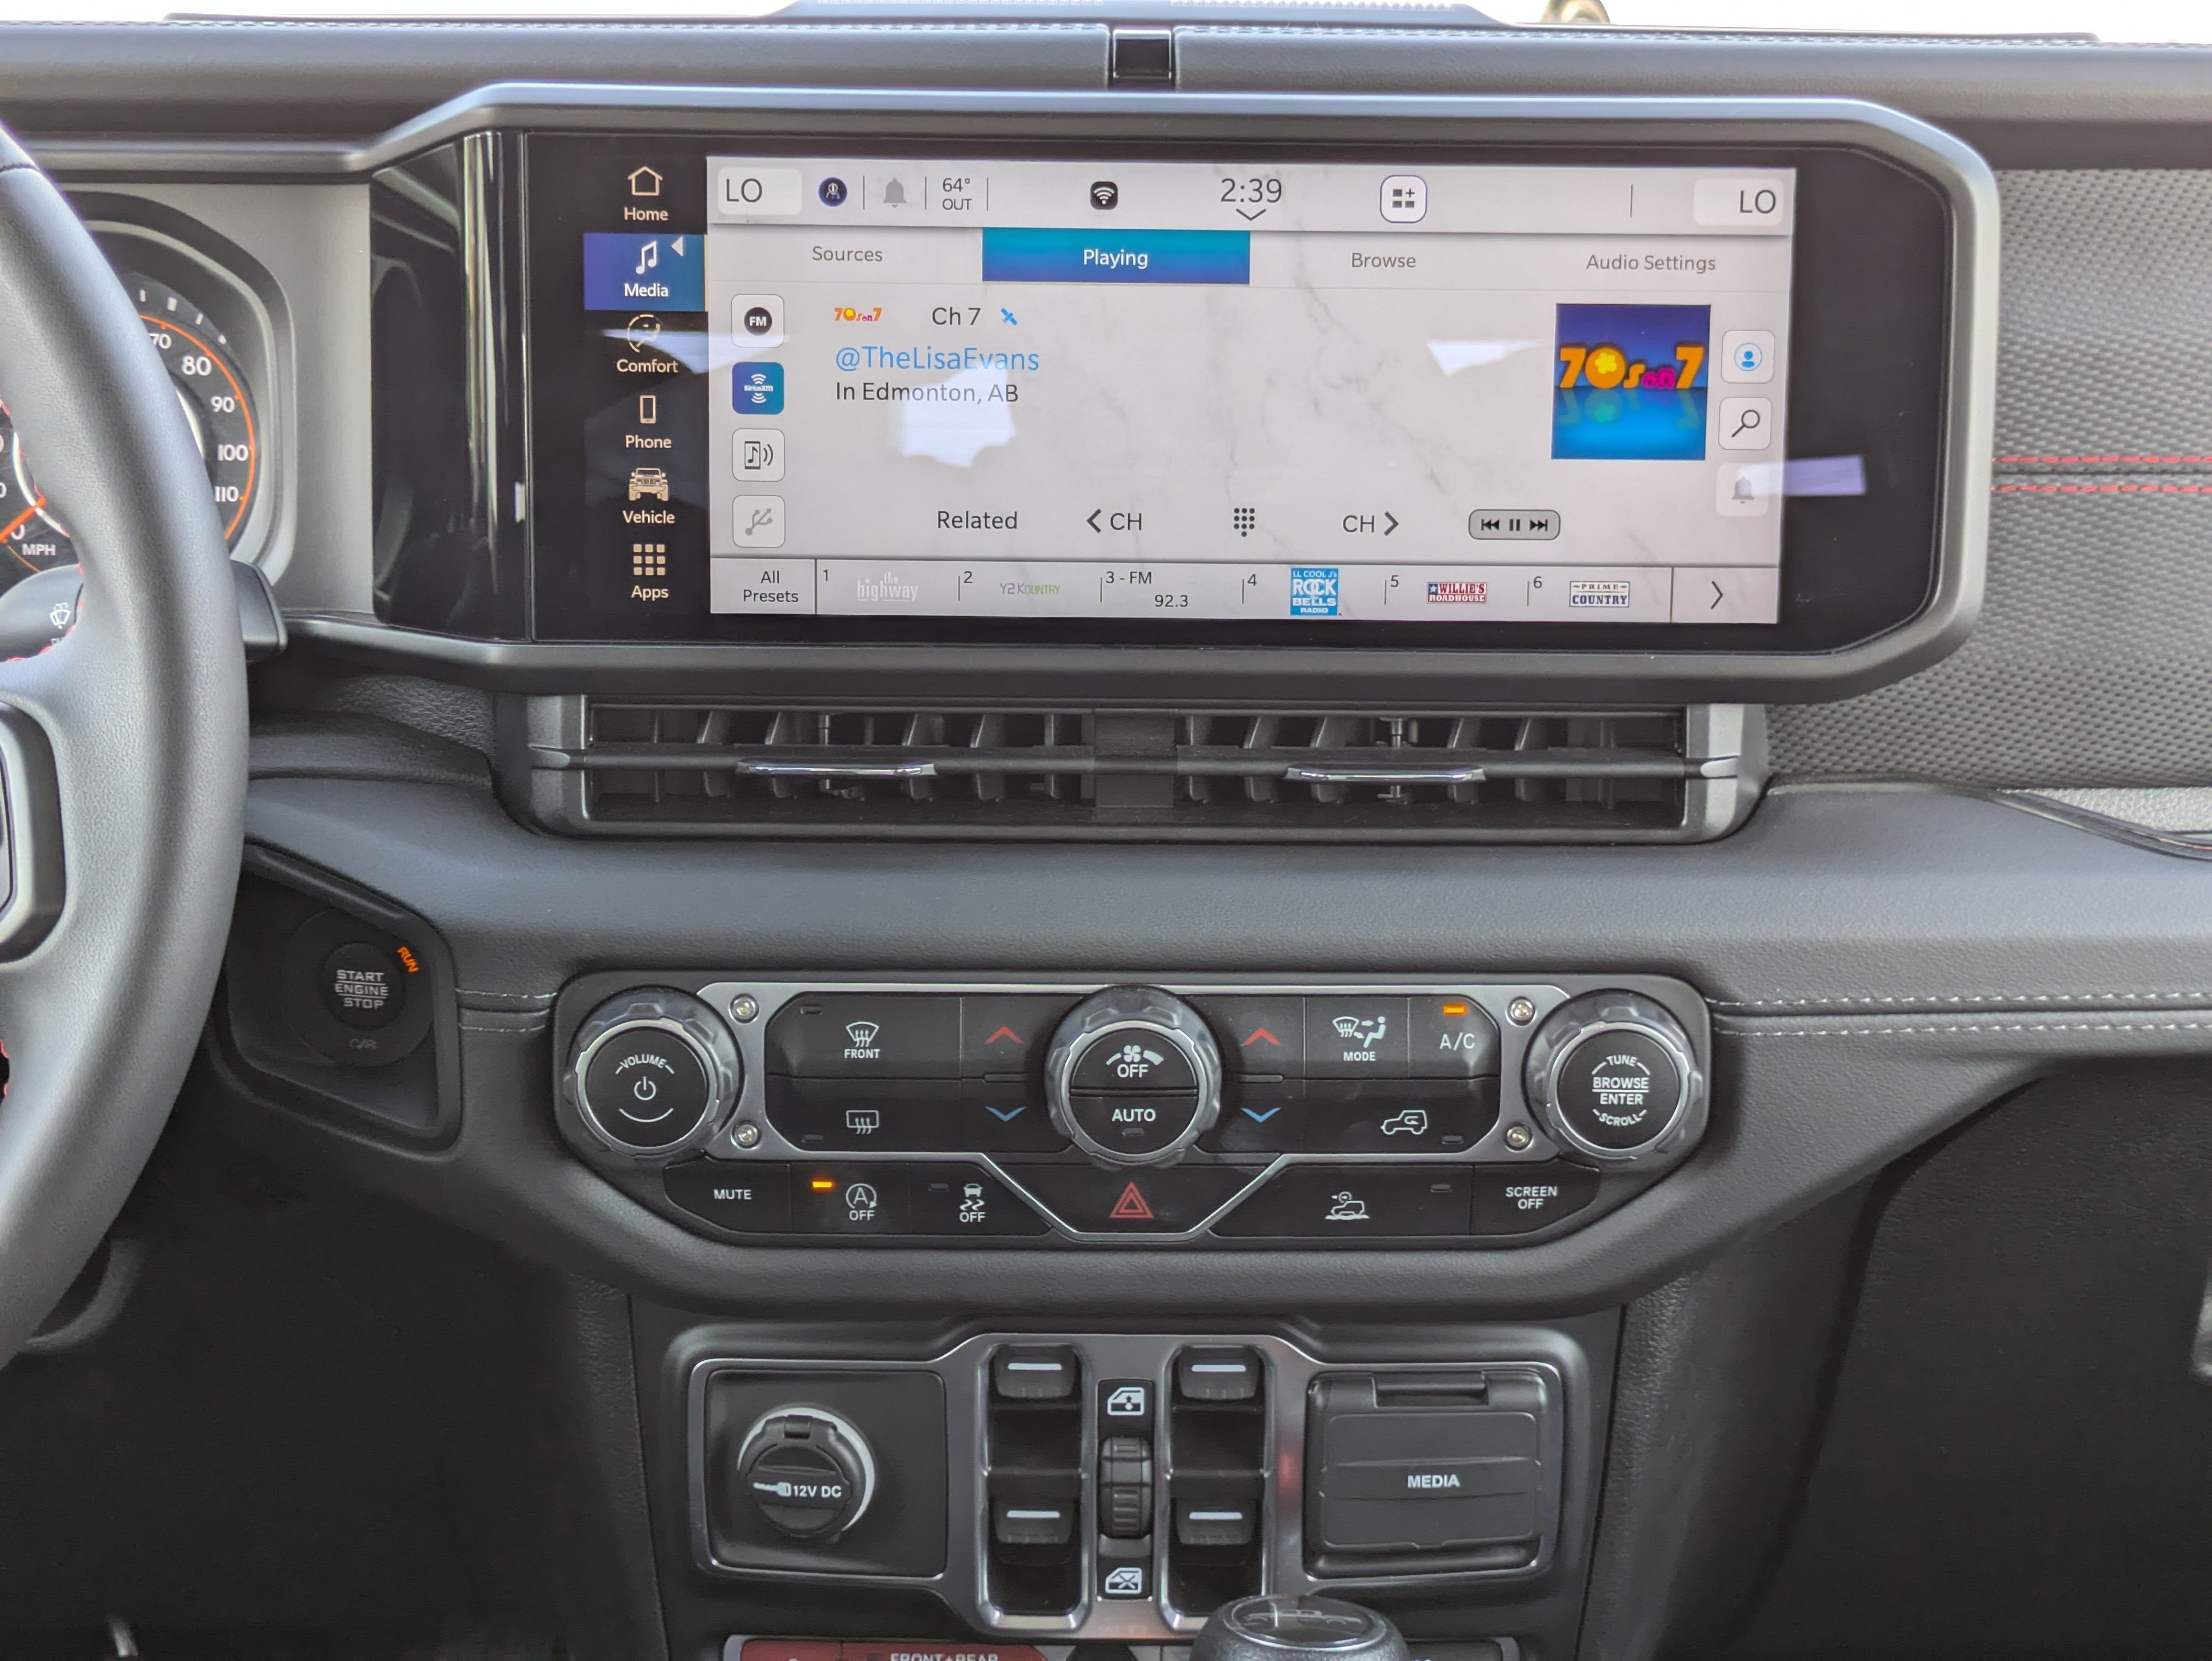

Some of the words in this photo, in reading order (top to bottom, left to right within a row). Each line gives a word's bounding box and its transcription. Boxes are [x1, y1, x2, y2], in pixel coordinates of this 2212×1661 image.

[726, 178, 763, 203] LO
[942, 178, 971, 192] 64°
[1221, 178, 1283, 204] 2:39
[942, 199, 973, 210] OUT
[1739, 189, 1777, 214] LO
[624, 208, 668, 221] Home
[812, 246, 883, 262] Sources
[1083, 249, 1149, 269] Playing
[1351, 253, 1416, 269] Browse
[1586, 254, 1639, 271] Audio
[1644, 255, 1716, 274] Settings
[624, 283, 669, 298] Media
[749, 316, 767, 326] FM
[932, 307, 961, 325] Ch
[968, 308, 981, 325] 7
[149, 333, 171, 349] 70
[181, 356, 212, 376] 80
[617, 359, 678, 373] Comfort
[836, 346, 1040, 372] @TheLisaEvans
[836, 382, 855, 400] In
[863, 382, 982, 405] Edmonton,
[987, 384, 1018, 402] AB
[210, 396, 235, 413] 90
[625, 435, 672, 449] Phone
[217, 444, 249, 461] 100
[215, 486, 239, 502] 110
[623, 510, 675, 525] Vehicle
[937, 510, 1018, 530] Related
[1110, 513, 1142, 531] CH
[1342, 515, 1375, 534] CH
[22, 543, 56, 555] MPH
[761, 571, 780, 584] All
[823, 570, 829, 582] 1
[884, 573, 898, 584] the
[964, 571, 973, 583] 2
[1106, 572, 1115, 584] 3
[1129, 572, 1152, 584] FM
[1247, 574, 1257, 586] 4
[1391, 575, 1399, 588] 5
[1533, 576, 1542, 589] 6
[631, 585, 669, 600] Apps
[857, 580, 918, 601] highway
[1293, 579, 1336, 595] ROCK
[743, 589, 798, 603] Presets
[1154, 595, 1188, 608] 92.3
[1293, 598, 1336, 606] BELLS
[1572, 595, 1627, 604] COUNTRY
[397, 946, 419, 973] RUN
[336, 969, 384, 982] START
[335, 983, 389, 996] ENGINE
[343, 997, 384, 1009] STOP
[1440, 1034, 1475, 1050] A/C
[619, 1054, 666, 1068] VOLUME
[844, 1049, 880, 1059] FRONT
[1344, 1052, 1375, 1062] MODE
[1606, 1055, 1637, 1066] TUNE
[1117, 1064, 1148, 1078] OFF
[1593, 1077, 1649, 1088] BROWSE
[1600, 1093, 1644, 1105] ENTER
[1112, 1108, 1155, 1121] AUTO
[1599, 1113, 1642, 1126] SCROLL
[714, 1189, 752, 1200] MUTE
[1506, 1186, 1558, 1197] SCREEN
[1517, 1198, 1543, 1209] OFF
[849, 1210, 875, 1220] OFF
[959, 1212, 985, 1222] OFF
[1407, 1474, 1460, 1488] MEDIA
[793, 1485, 817, 1497] 12V
[821, 1485, 842, 1497] DC
